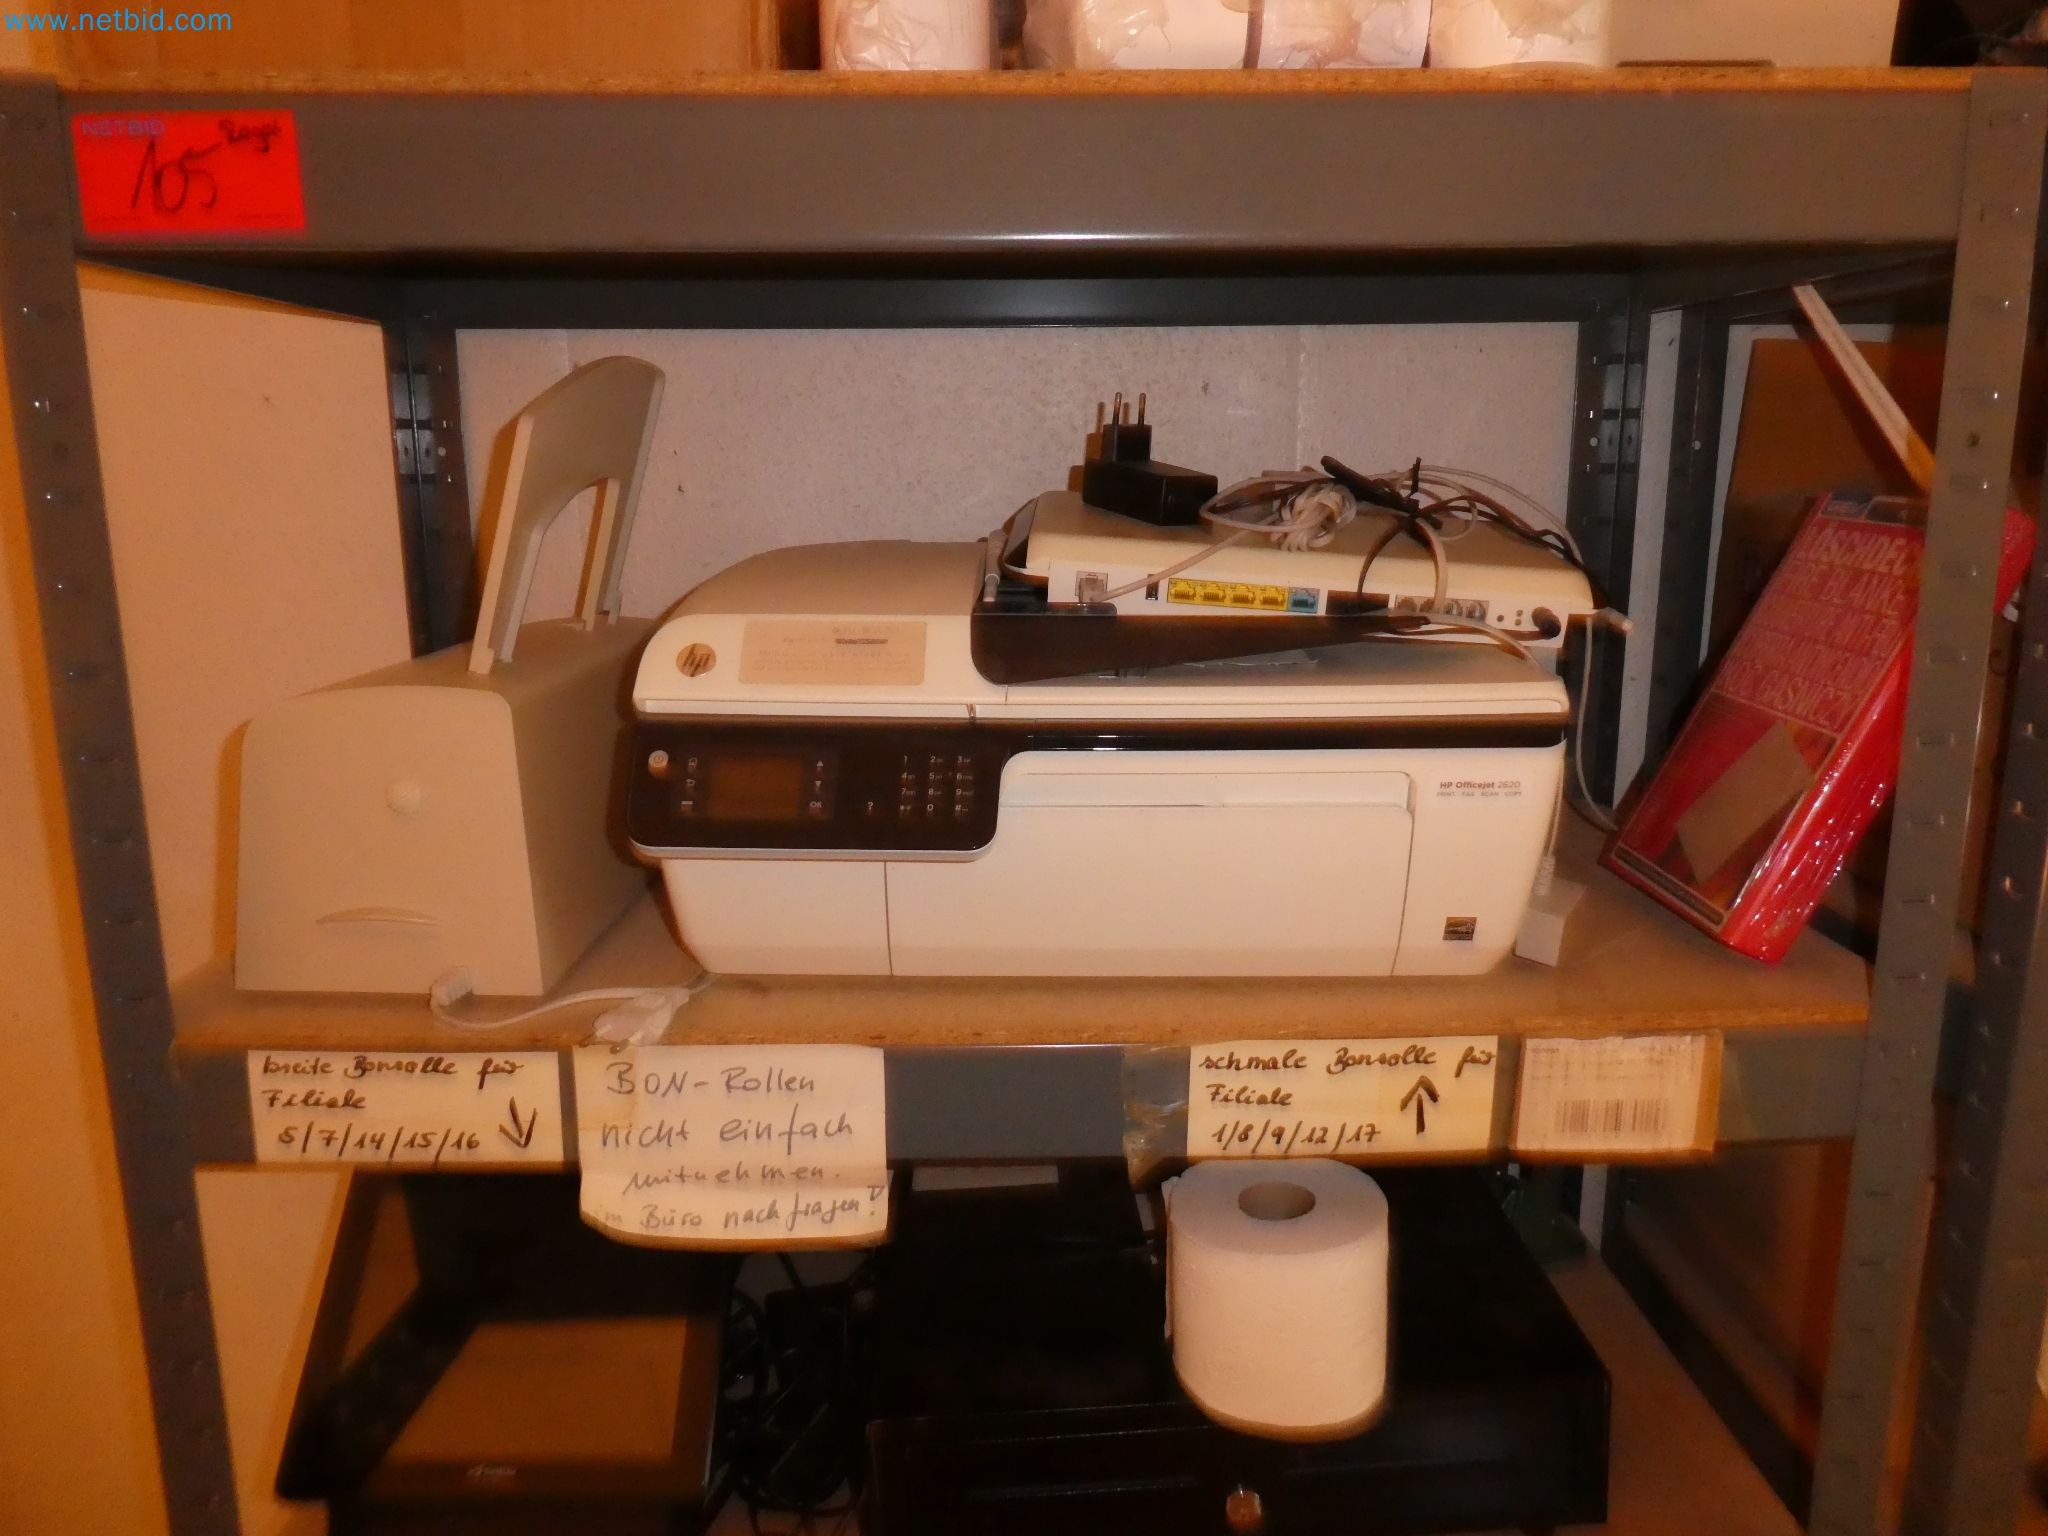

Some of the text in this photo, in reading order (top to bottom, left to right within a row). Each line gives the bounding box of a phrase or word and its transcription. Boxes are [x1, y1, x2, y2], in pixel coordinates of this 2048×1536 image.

[1439, 781, 1453, 790] HP
[1455, 781, 1495, 790] Officejet
[1199, 1048, 1307, 1072] schmale
[261, 1088, 366, 1109] Filiale
[1205, 1082, 1293, 1107] Filiale
[602, 1118, 691, 1149] nicht
[719, 1102, 853, 1156] einfach
[1211, 1118, 1382, 1155] 1/8/9/12/17
[277, 1120, 481, 1167] 5/7/14/15/16
[640, 1203, 703, 1229] Büro
